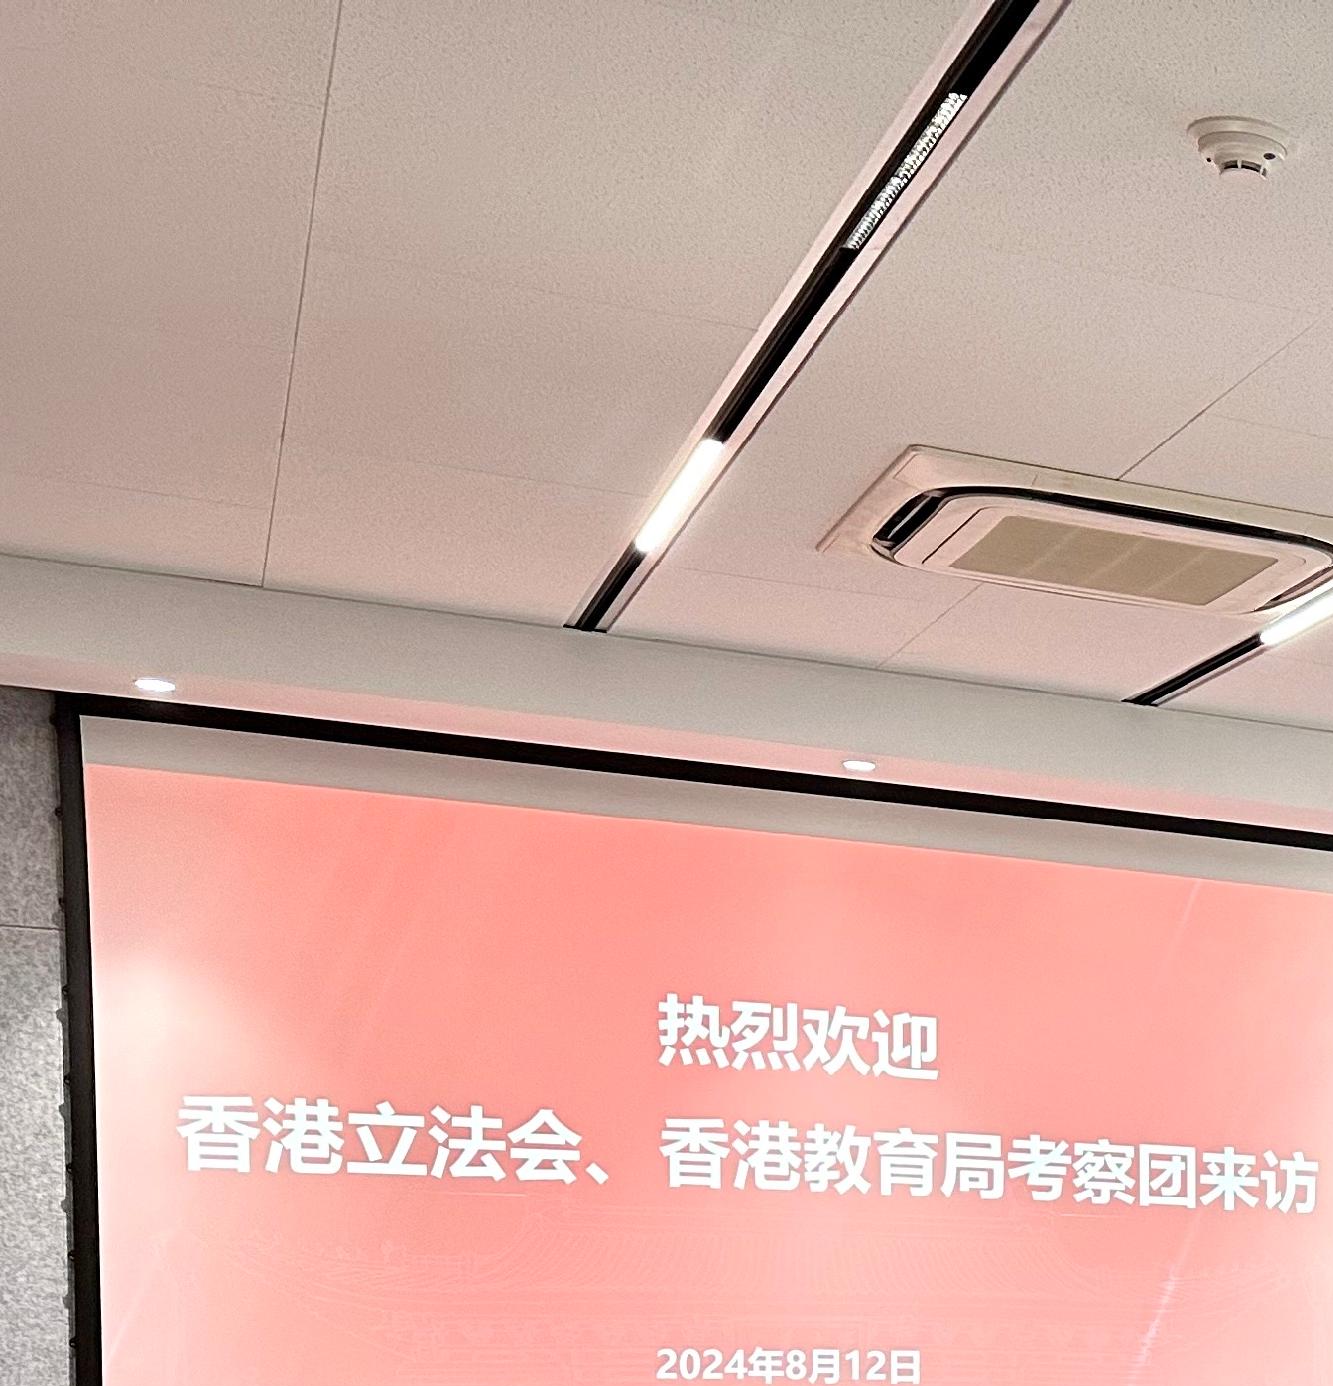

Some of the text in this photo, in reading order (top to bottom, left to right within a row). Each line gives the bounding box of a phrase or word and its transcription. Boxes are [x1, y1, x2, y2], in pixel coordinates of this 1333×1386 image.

[657, 993, 939, 1082] 热烈欢迎
[176, 1095, 1319, 1215] 香港立法会、香港教育局考察团来访
[656, 1346, 922, 1386] 2024年8月12日
